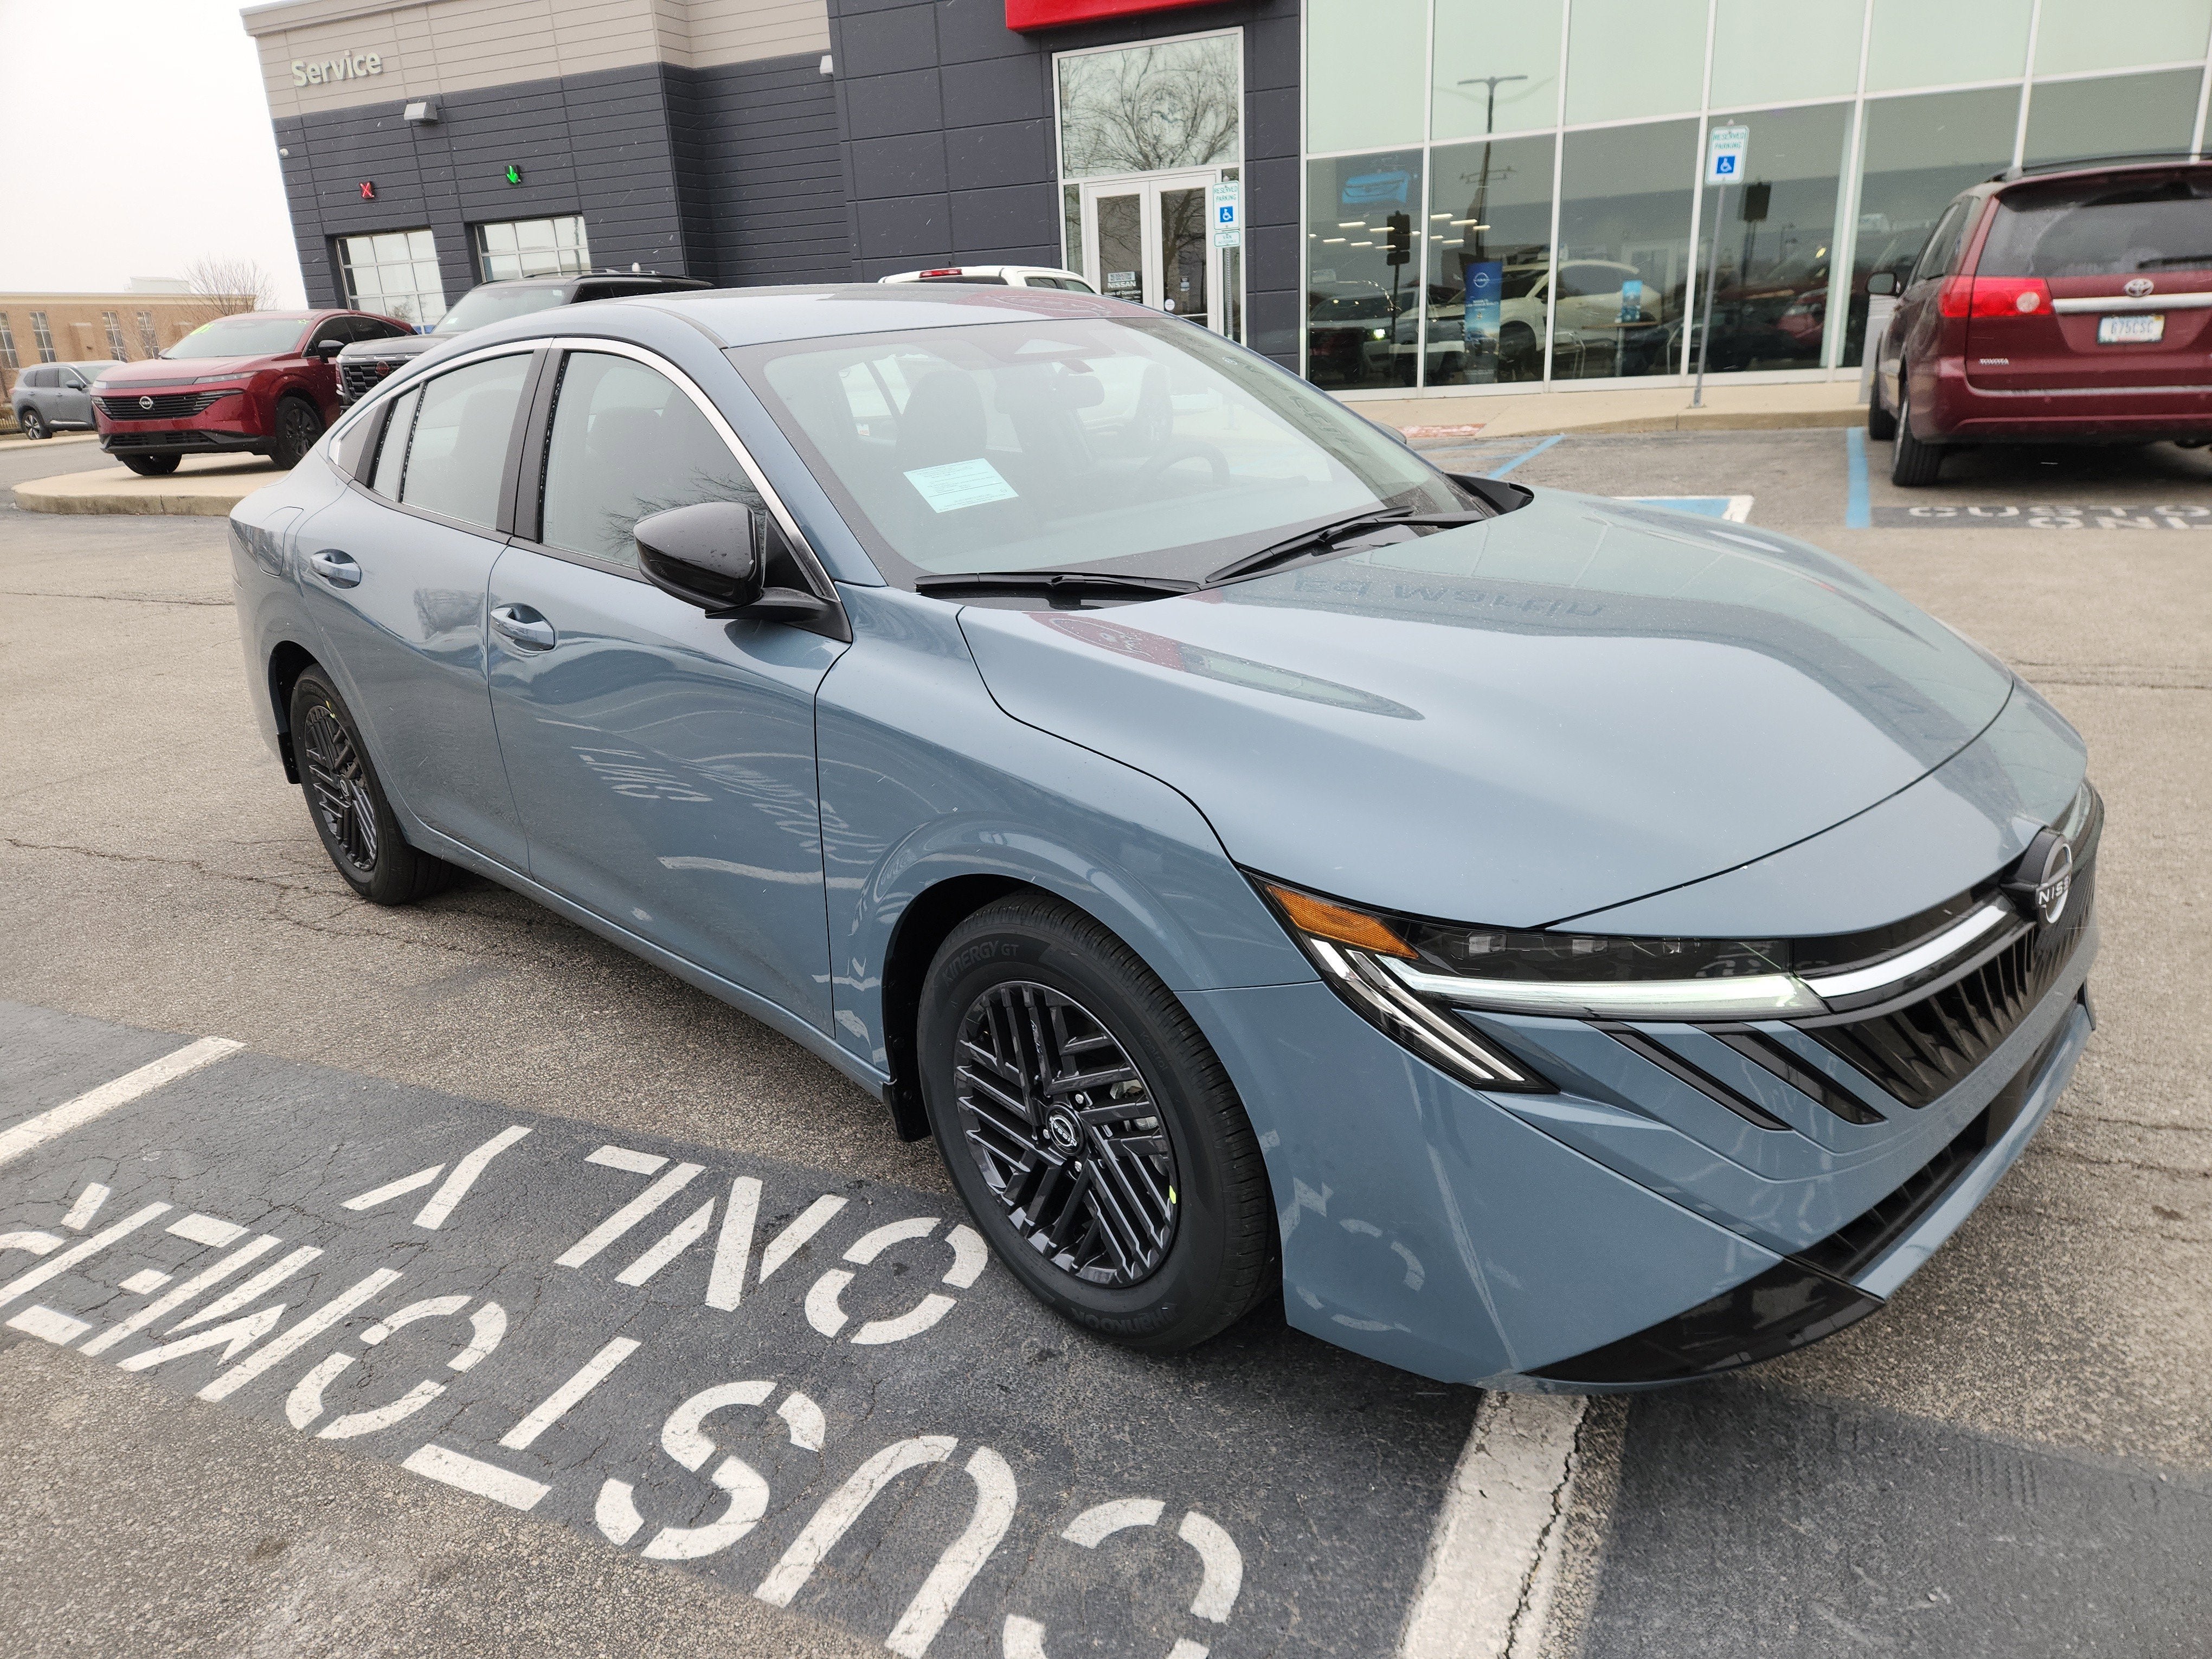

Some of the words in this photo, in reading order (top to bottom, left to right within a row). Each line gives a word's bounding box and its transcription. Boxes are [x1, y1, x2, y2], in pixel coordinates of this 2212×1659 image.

[291, 49, 382, 86] Service
[1001, 943, 1019, 957] GT
[1049, 1116, 1077, 1147] NISSAN
[340, 1126, 988, 1345] ONLY
[0, 1182, 1243, 1659] CUSTOMER
